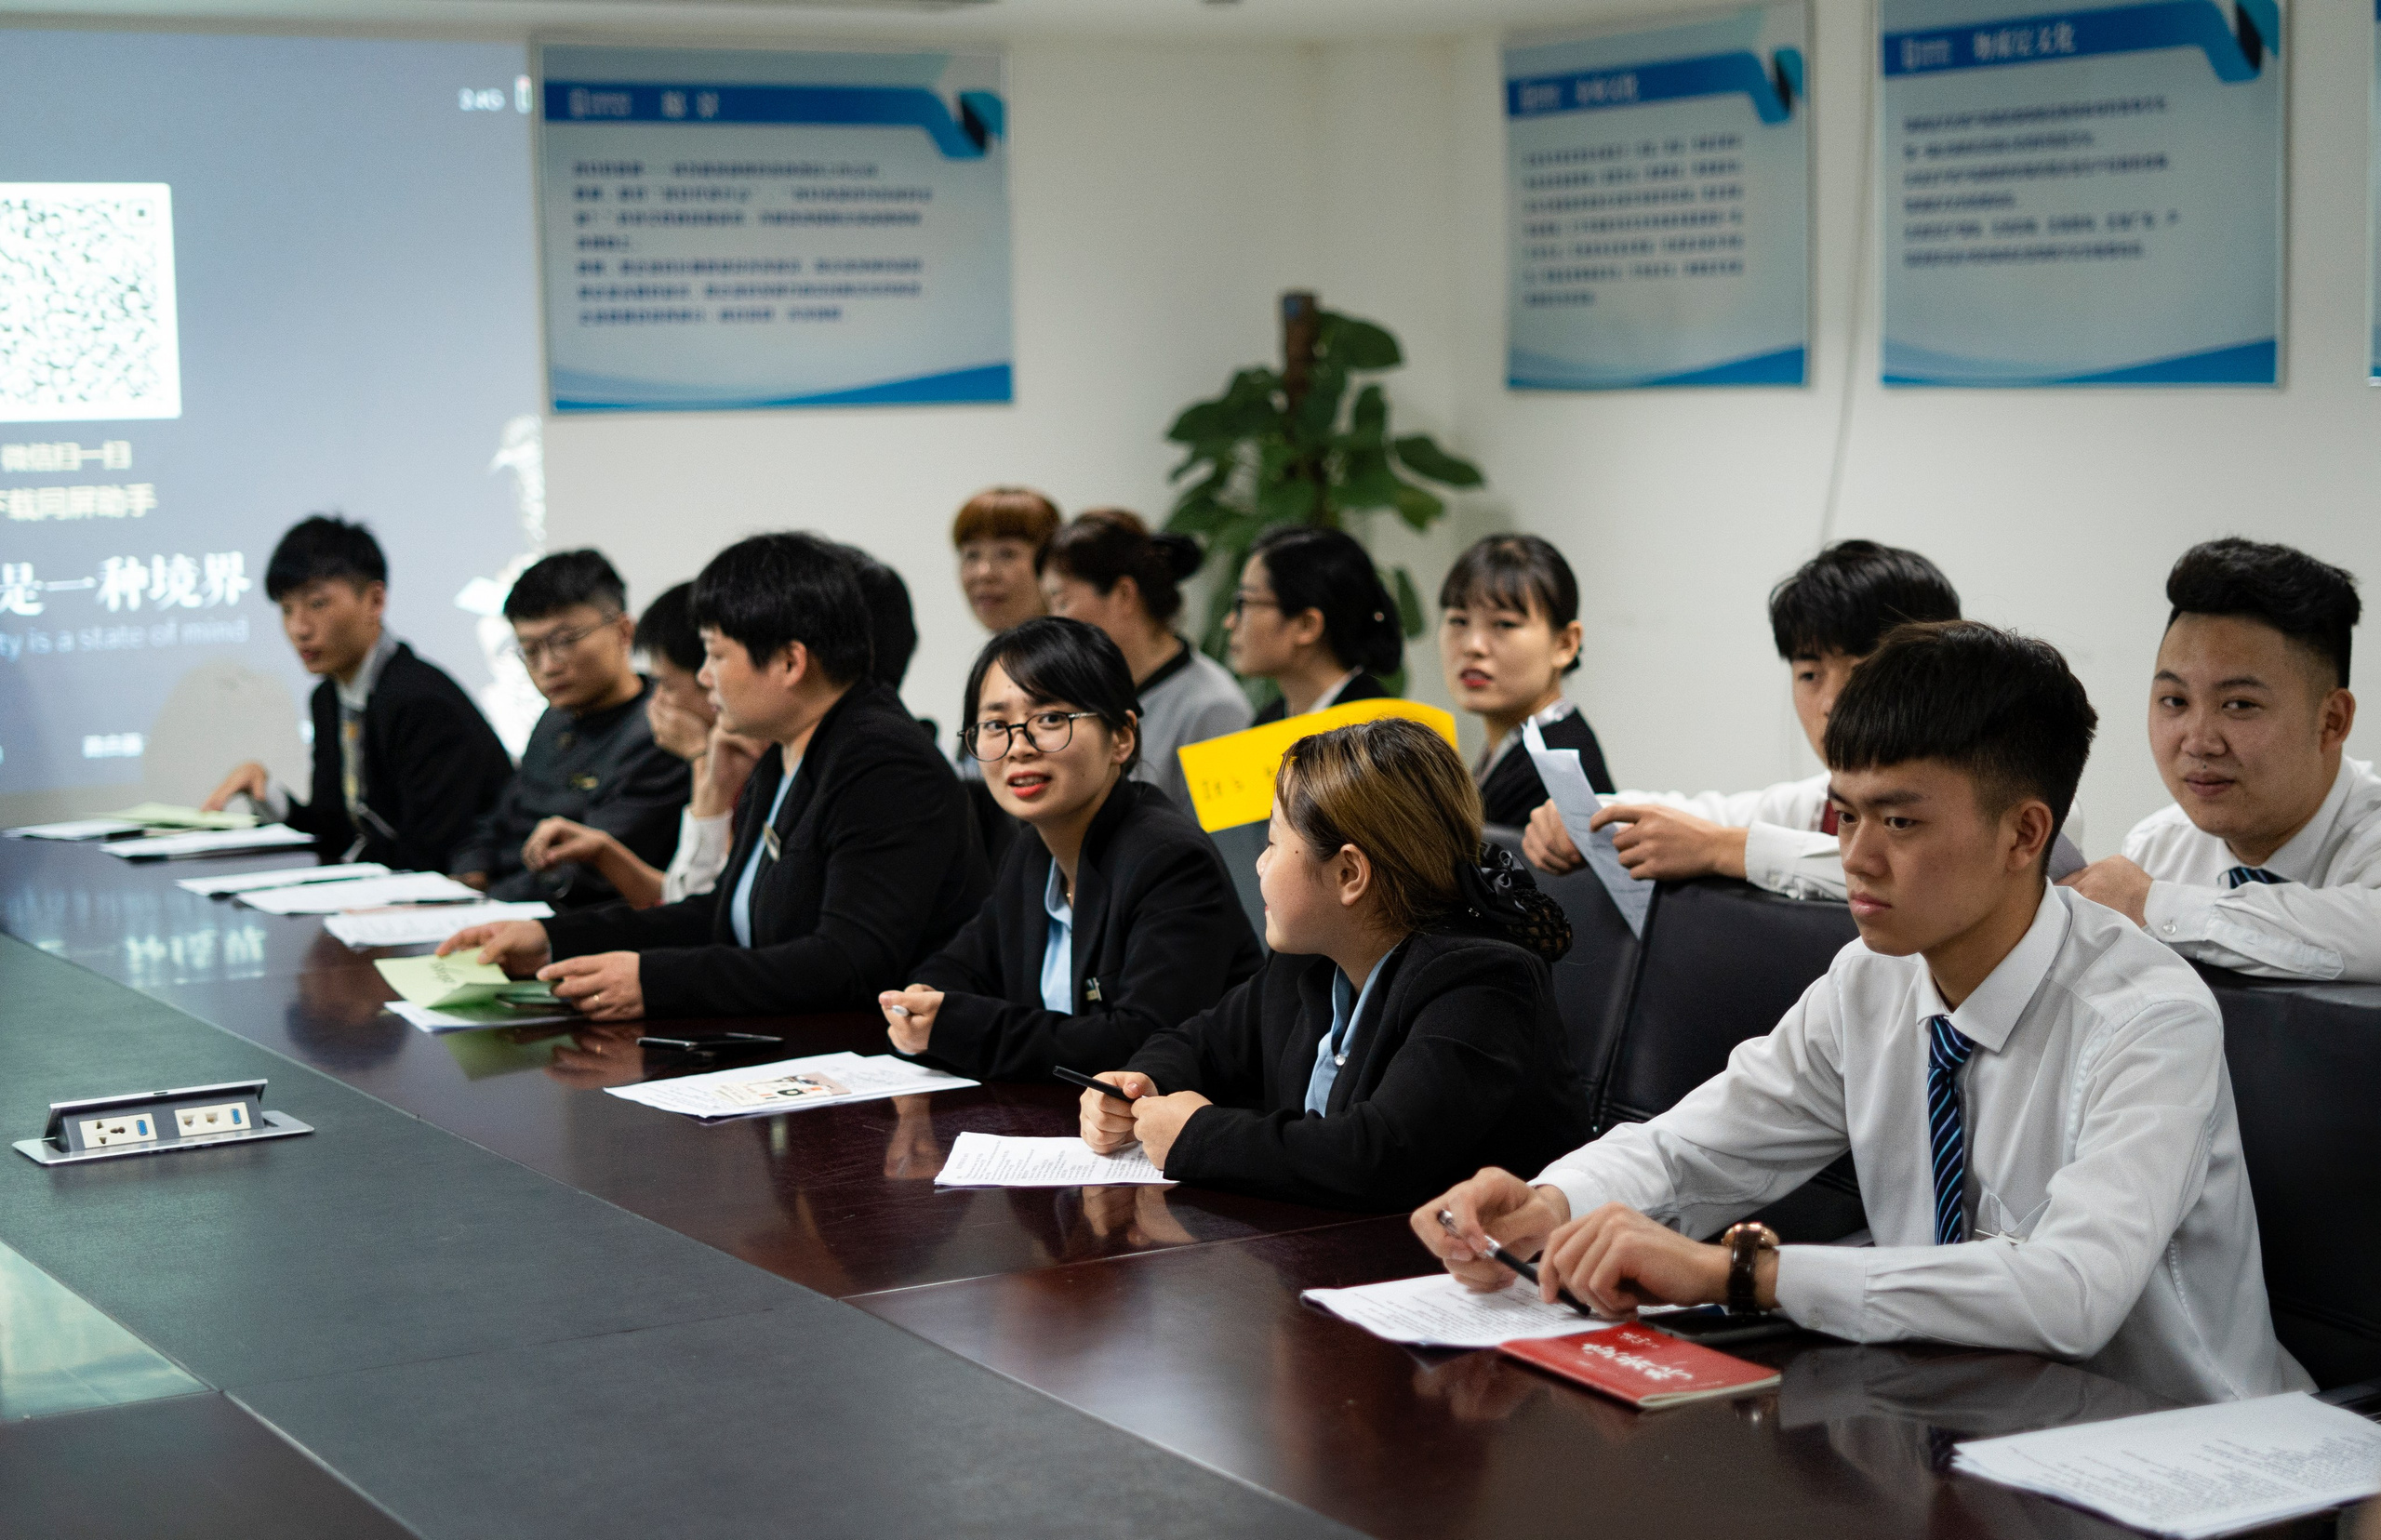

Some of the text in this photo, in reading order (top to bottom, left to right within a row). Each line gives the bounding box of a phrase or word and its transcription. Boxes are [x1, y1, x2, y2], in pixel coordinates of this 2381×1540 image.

[0, 551, 252, 616] 是一种境界
[26, 626, 53, 655] is
[55, 630, 74, 653] a
[77, 625, 147, 650] state
[149, 616, 177, 647] of
[180, 613, 250, 644] mind
